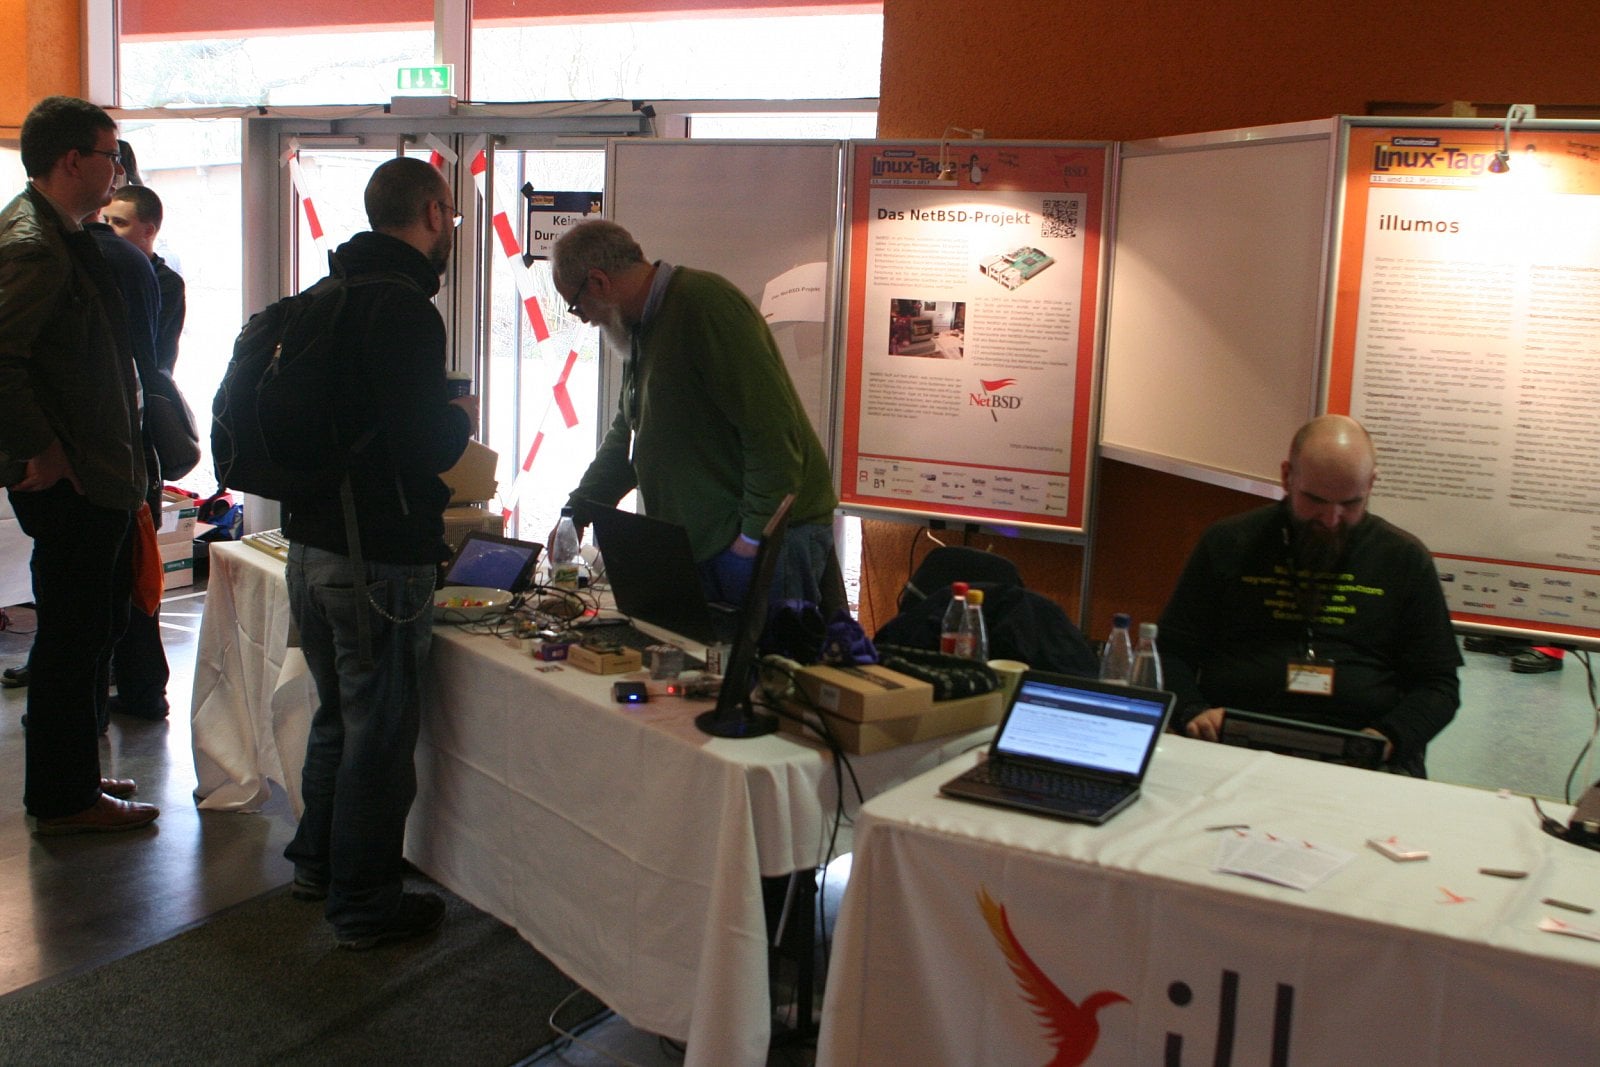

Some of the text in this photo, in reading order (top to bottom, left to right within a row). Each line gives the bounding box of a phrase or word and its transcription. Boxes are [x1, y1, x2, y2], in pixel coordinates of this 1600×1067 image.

[1374, 146, 1486, 175] Linux-Tag
[878, 208, 1031, 226] Das NetBSD-Projekt
[1379, 214, 1460, 233] illumos
[969, 393, 1021, 409] NetBSD
